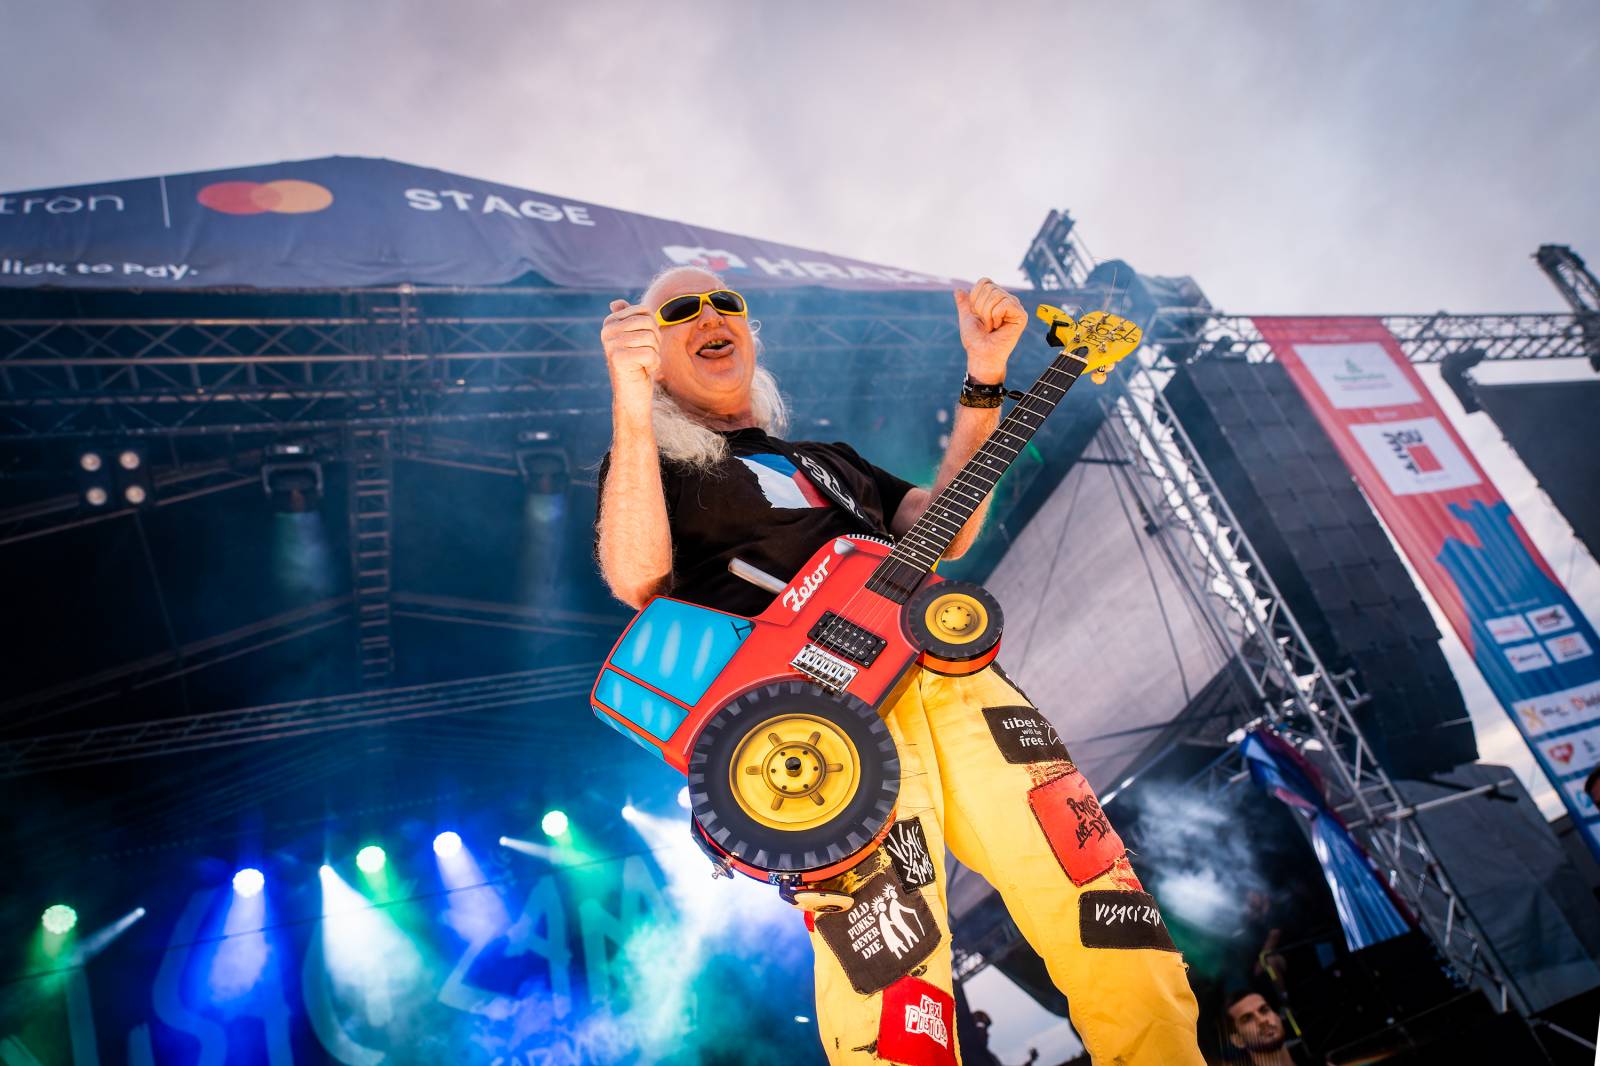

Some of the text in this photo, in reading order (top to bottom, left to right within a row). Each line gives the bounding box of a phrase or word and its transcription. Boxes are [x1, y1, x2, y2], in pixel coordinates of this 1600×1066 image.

[404, 187, 596, 227] STAGE
[76, 263, 114, 274] to
[123, 262, 199, 280] Pay.
[782, 554, 831, 612] Zetor
[1002, 717, 1038, 730] tibet
[1019, 735, 1048, 747] free.
[847, 902, 870, 924] OLD
[847, 912, 876, 940] PUNKS
[851, 926, 880, 952] NEVER
[861, 939, 884, 959] DIE
